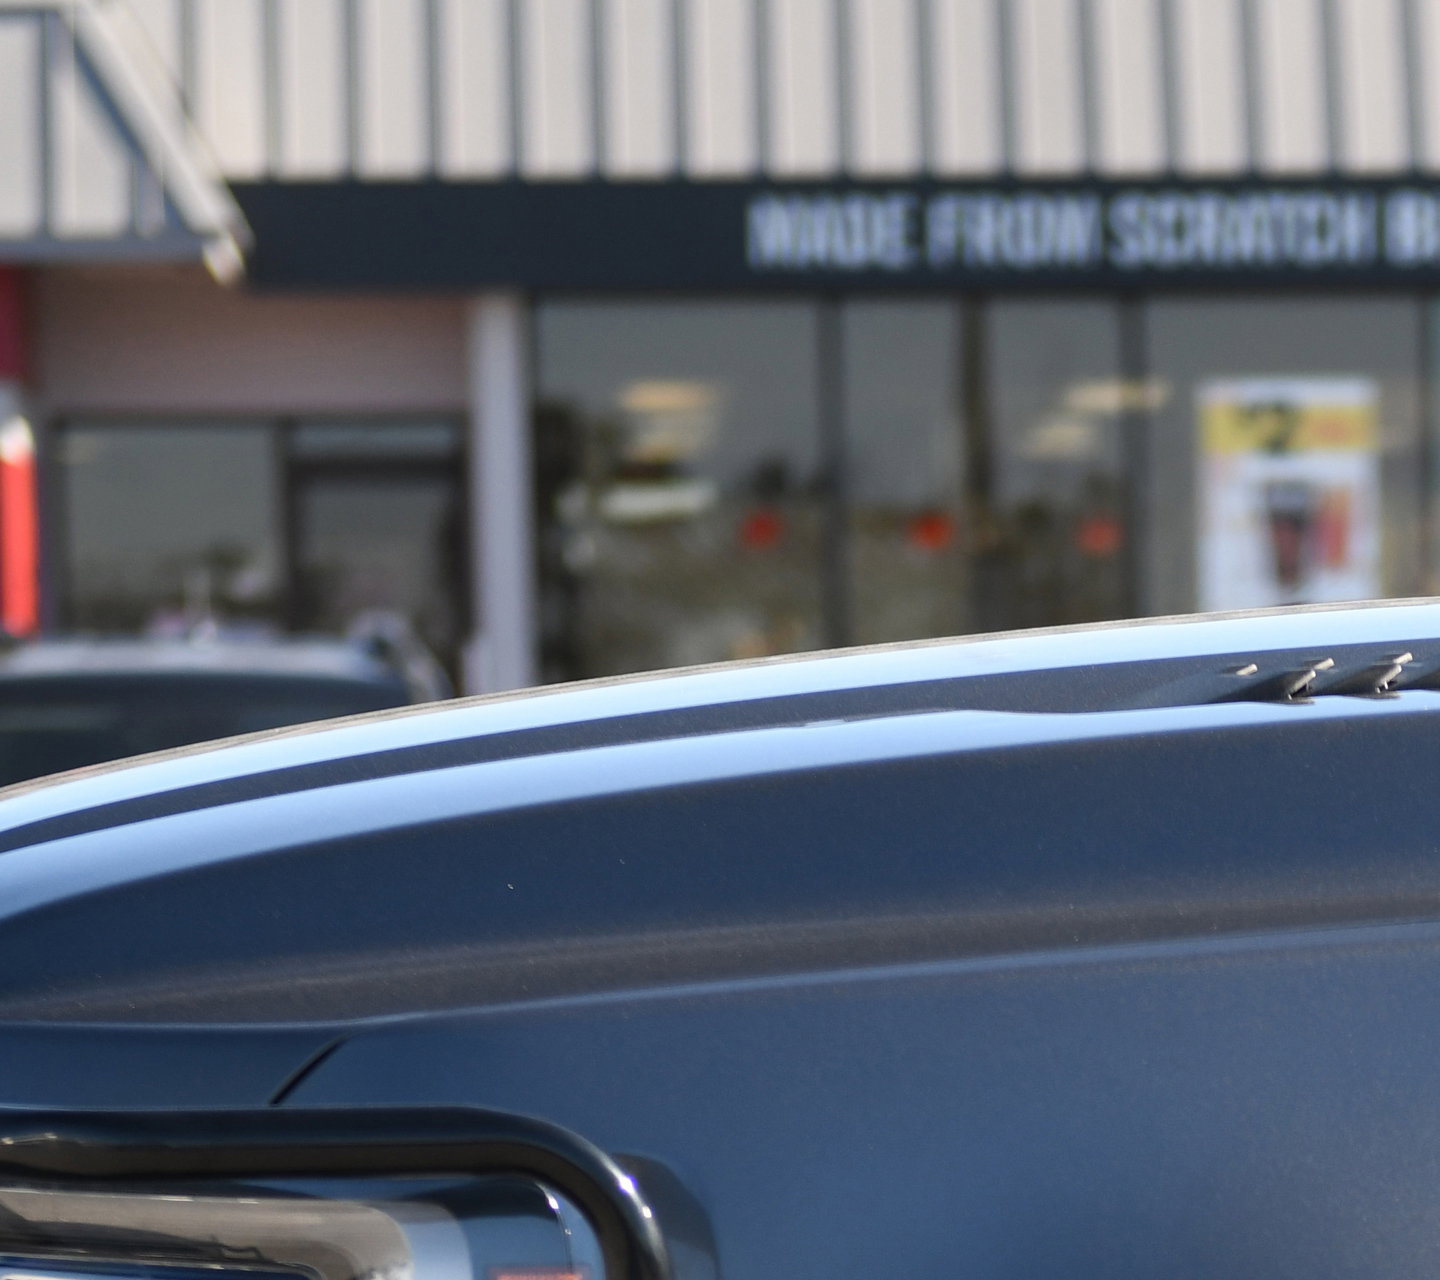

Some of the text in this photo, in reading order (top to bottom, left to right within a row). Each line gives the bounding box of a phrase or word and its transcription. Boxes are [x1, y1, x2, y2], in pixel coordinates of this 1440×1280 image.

[747, 192, 920, 267] MADE
[925, 192, 1103, 266] FROM
[1107, 190, 1376, 265] SCRATCH
